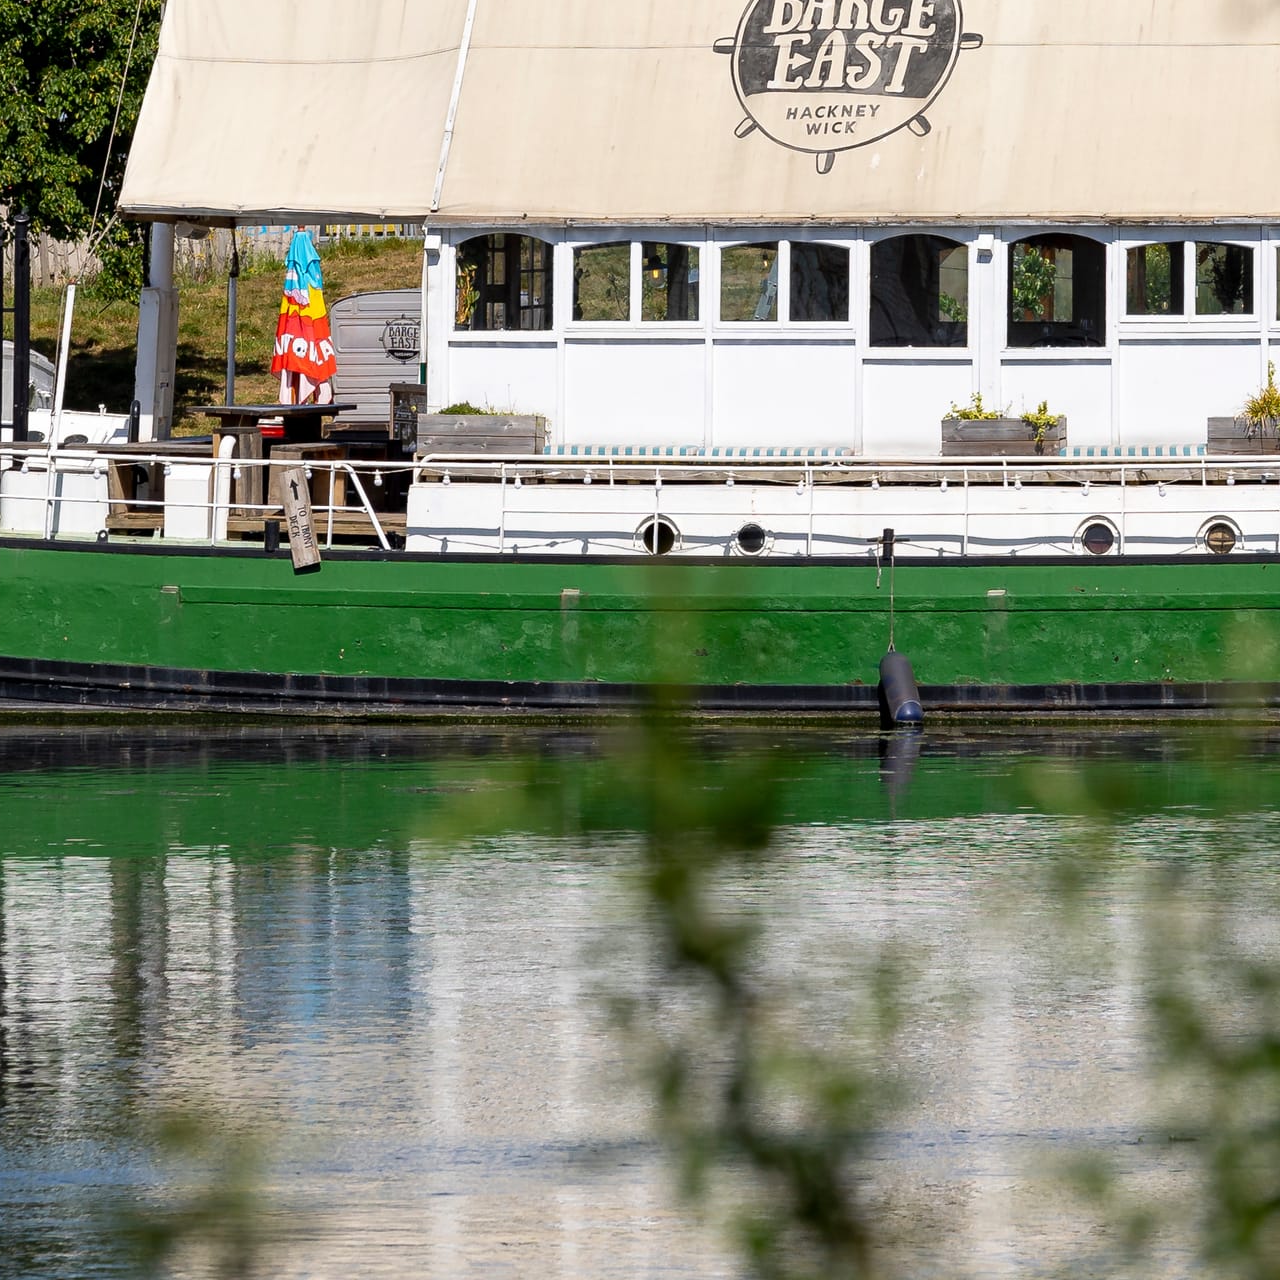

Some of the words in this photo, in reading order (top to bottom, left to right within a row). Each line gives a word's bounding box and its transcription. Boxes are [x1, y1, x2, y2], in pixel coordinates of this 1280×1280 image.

[767, 30, 929, 93] EAST
[786, 104, 881, 120] HACKNEY
[806, 121, 857, 135] WICK
[388, 326, 420, 338] BARGE
[390, 336, 419, 350] EAST
[297, 504, 308, 517] TO
[289, 515, 301, 538] DECK
